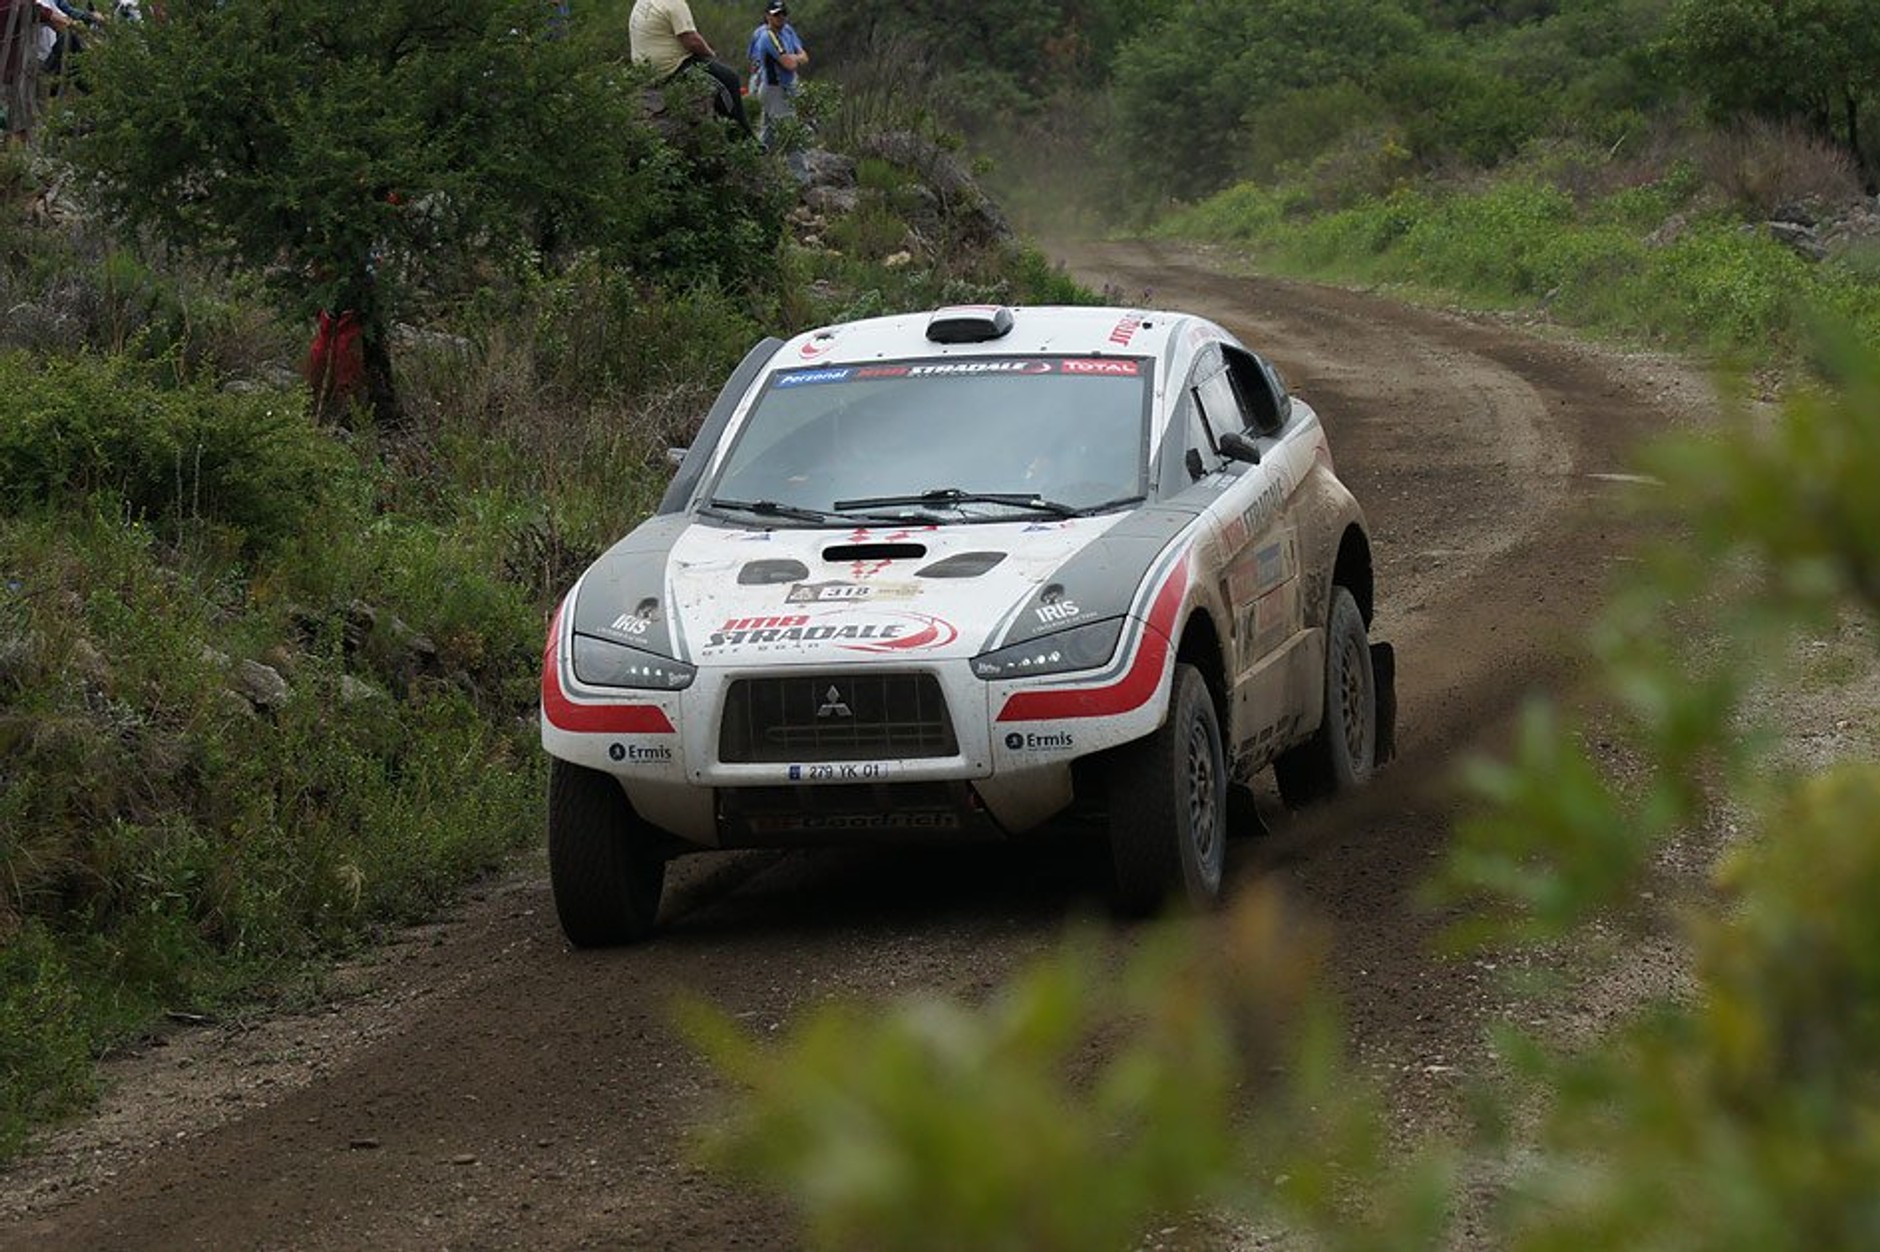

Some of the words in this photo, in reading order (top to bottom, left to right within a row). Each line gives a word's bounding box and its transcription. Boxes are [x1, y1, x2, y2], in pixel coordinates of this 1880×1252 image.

[1066, 360, 1136, 373] TOTAL
[780, 369, 849, 385] Personal
[826, 586, 871, 597] 318
[1035, 600, 1080, 623] IRIS
[611, 613, 651, 635] IRIS
[702, 625, 904, 648] STRADALE
[1026, 731, 1074, 747] Ermis
[628, 744, 672, 759] Ermis
[840, 764, 857, 778] YK
